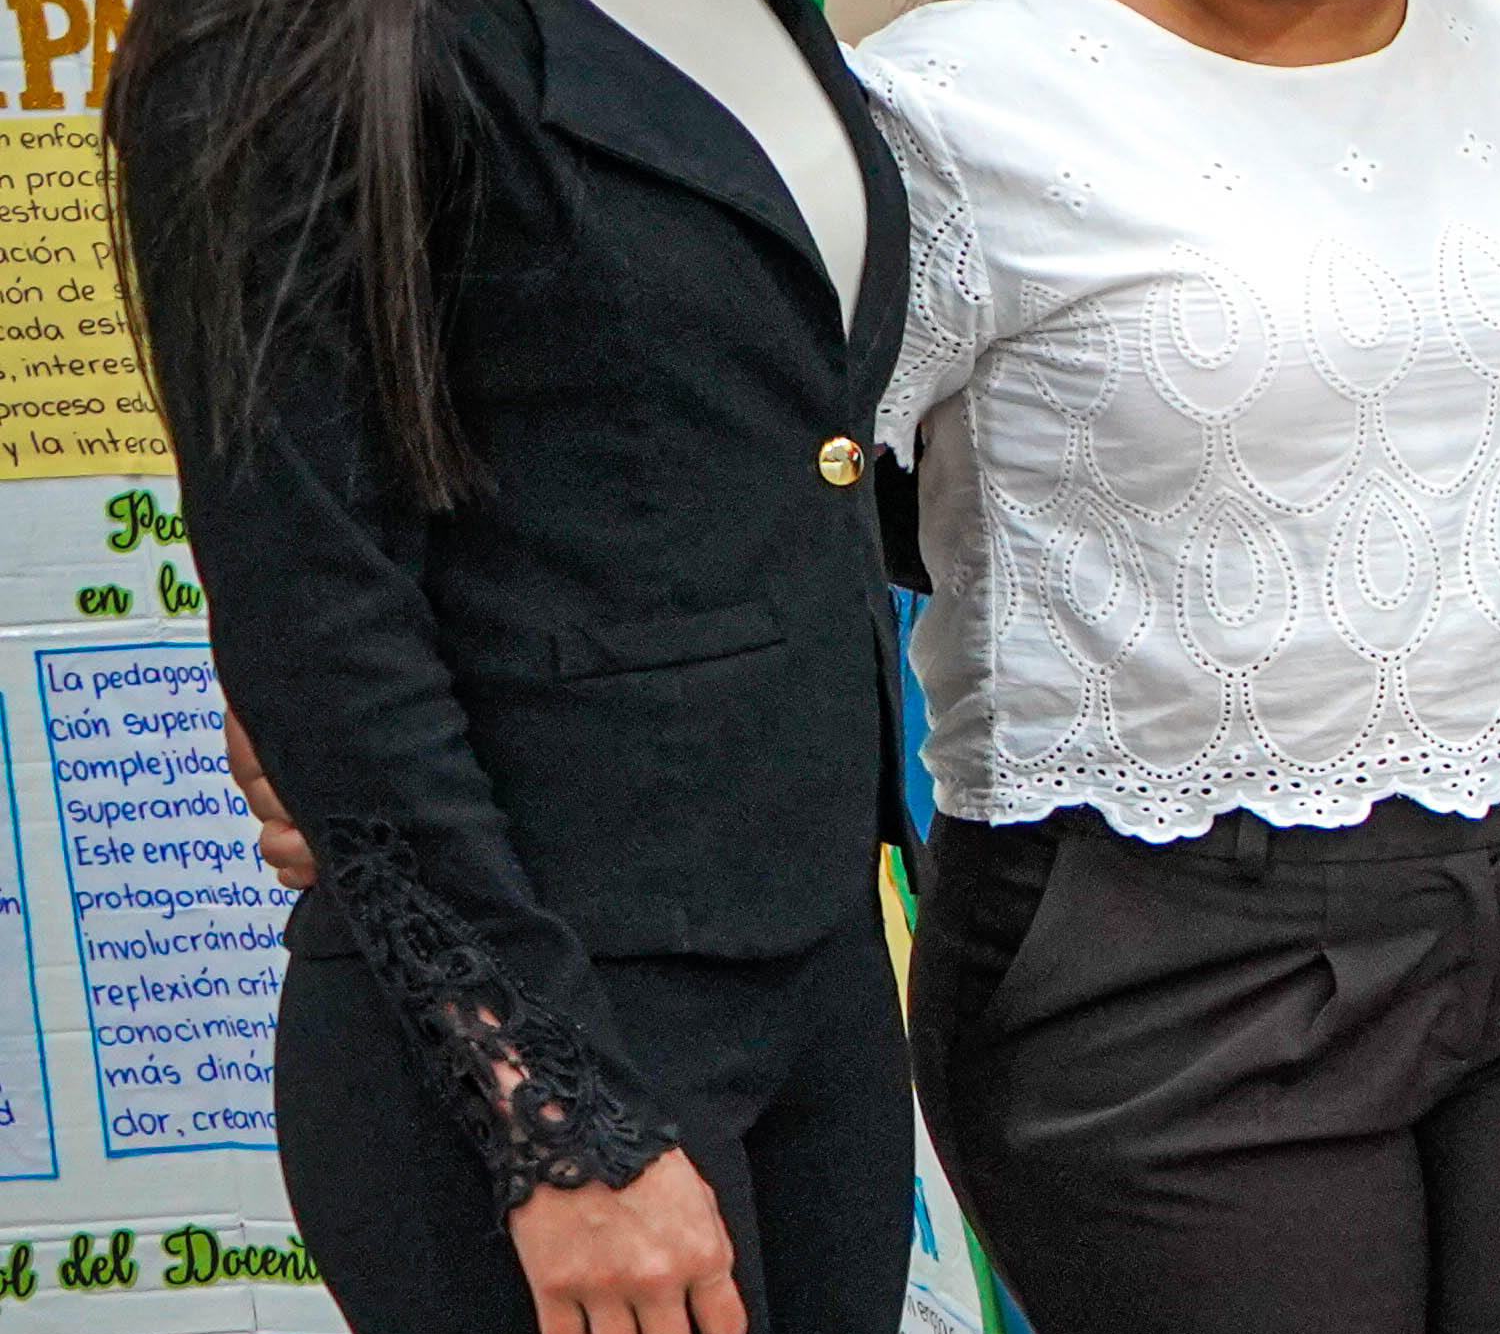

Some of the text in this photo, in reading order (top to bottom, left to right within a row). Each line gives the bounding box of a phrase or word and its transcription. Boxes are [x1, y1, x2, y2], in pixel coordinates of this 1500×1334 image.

[94, 660, 218, 699] pedagogí
[123, 709, 224, 738] superio
[238, 967, 281, 995] crít
[62, 1226, 319, 1287] del Docent
